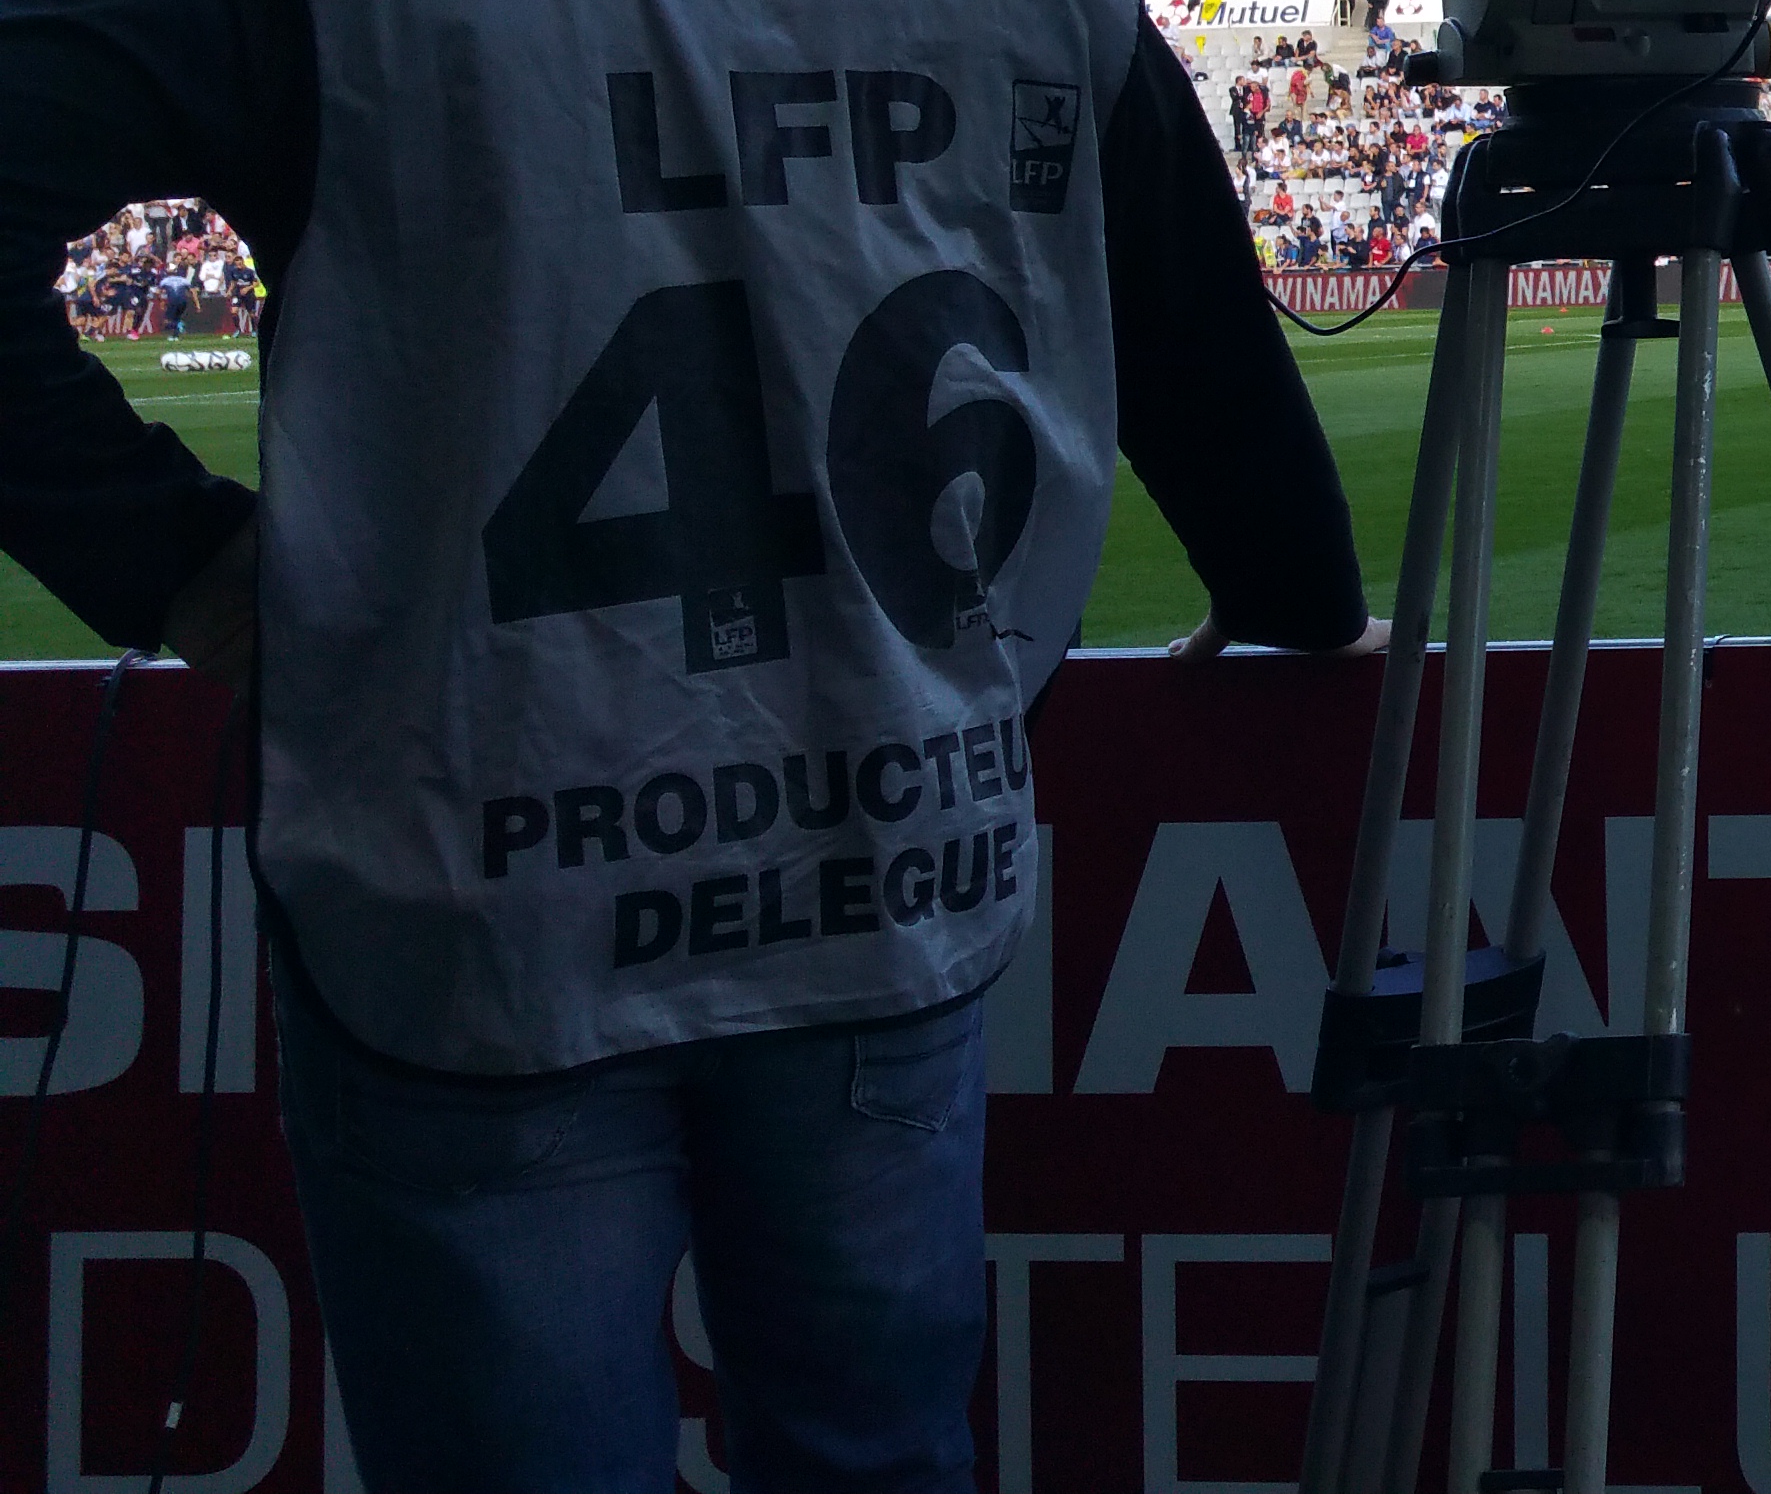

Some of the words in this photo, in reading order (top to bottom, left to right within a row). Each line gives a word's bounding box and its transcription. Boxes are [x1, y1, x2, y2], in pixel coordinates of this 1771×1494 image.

[606, 68, 957, 214] LFP
[1010, 158, 1064, 186] LFP
[1267, 273, 1399, 311] WINAMAX
[1508, 268, 1611, 306] INAMAX
[481, 268, 1037, 675] 46
[713, 625, 754, 646] LFP
[614, 822, 1019, 969] DELEGUE
